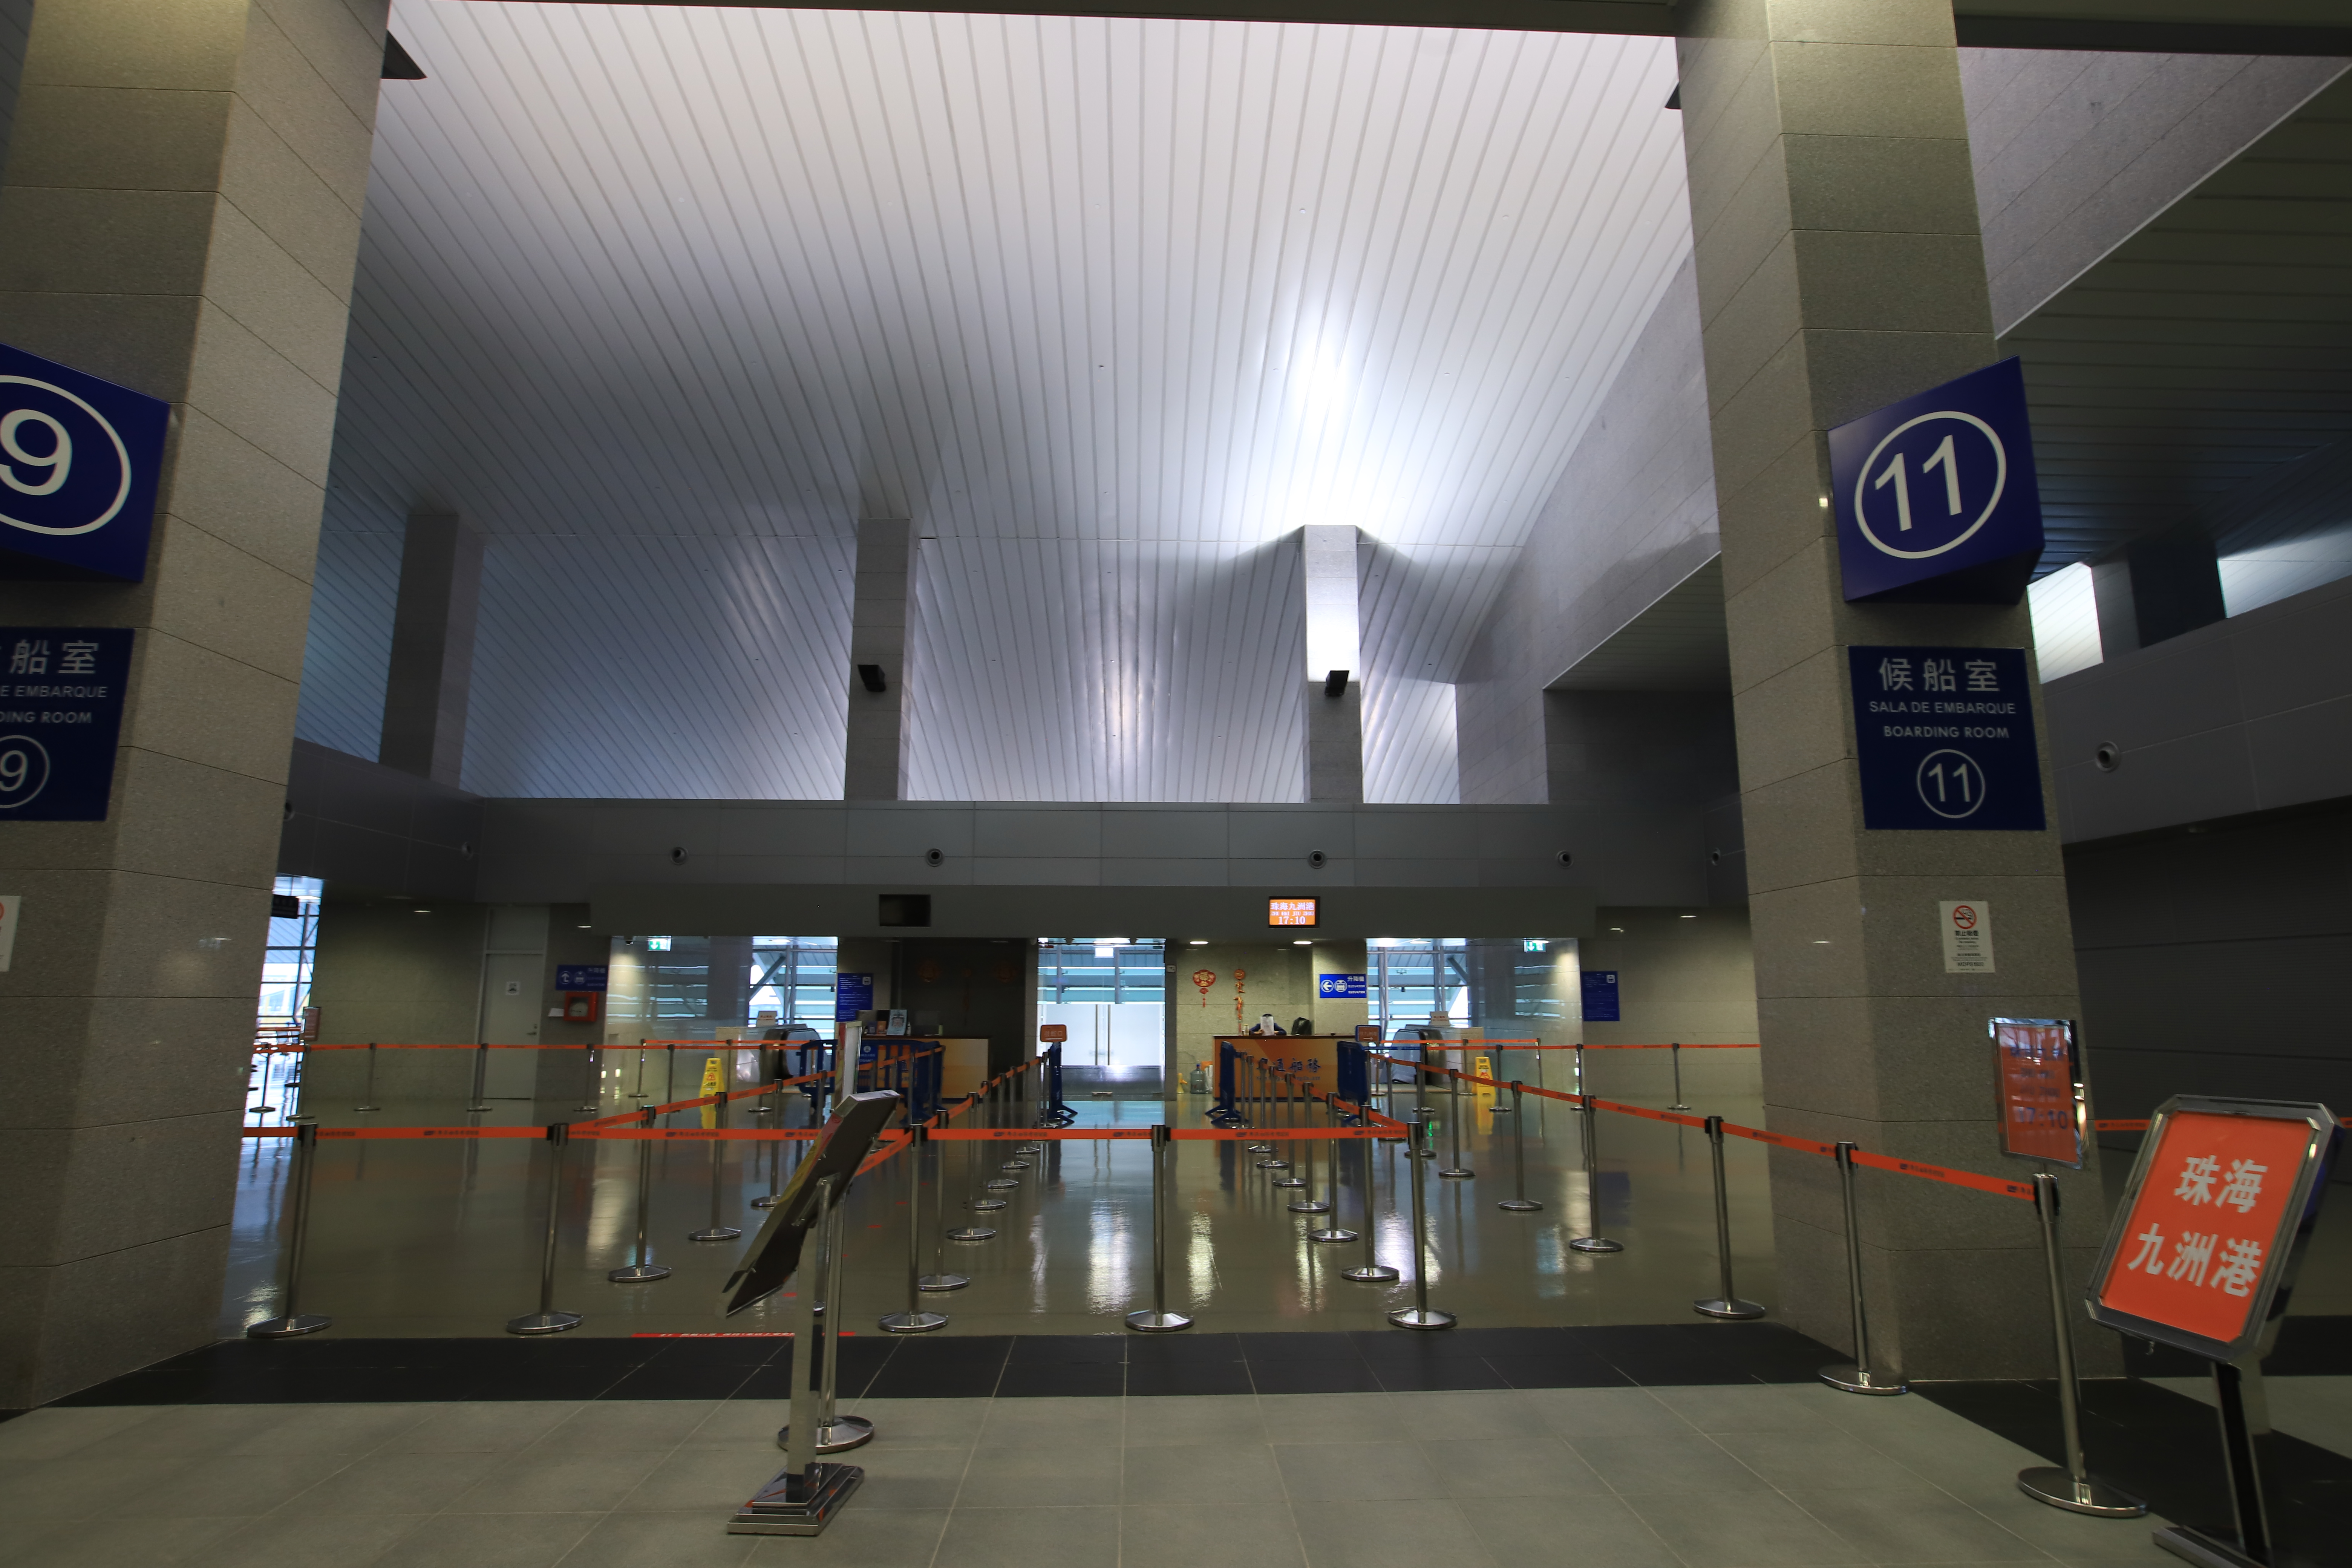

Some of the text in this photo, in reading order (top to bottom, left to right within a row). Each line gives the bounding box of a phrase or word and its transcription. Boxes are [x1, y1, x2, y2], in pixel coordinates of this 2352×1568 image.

[0, 409, 72, 495] 9
[1875, 435, 1962, 531] 11
[0, 640, 99, 674] 船室
[1879, 658, 2000, 691] 候船室
[15, 686, 107, 698] EMBARQUE
[1869, 701, 2016, 714] SALA DE EMBARQUE
[41, 712, 92, 723] ROOM
[1884, 726, 2009, 738] BOARDING ROOM
[0, 750, 28, 792] 9
[1928, 763, 1971, 802] 11
[1270, 902, 1314, 910] 珠海九洲港
[2018, 1107, 2068, 1130] 17:10
[2174, 1155, 2268, 1213] 珠海
[2127, 1223, 2262, 1297] 九洲港
